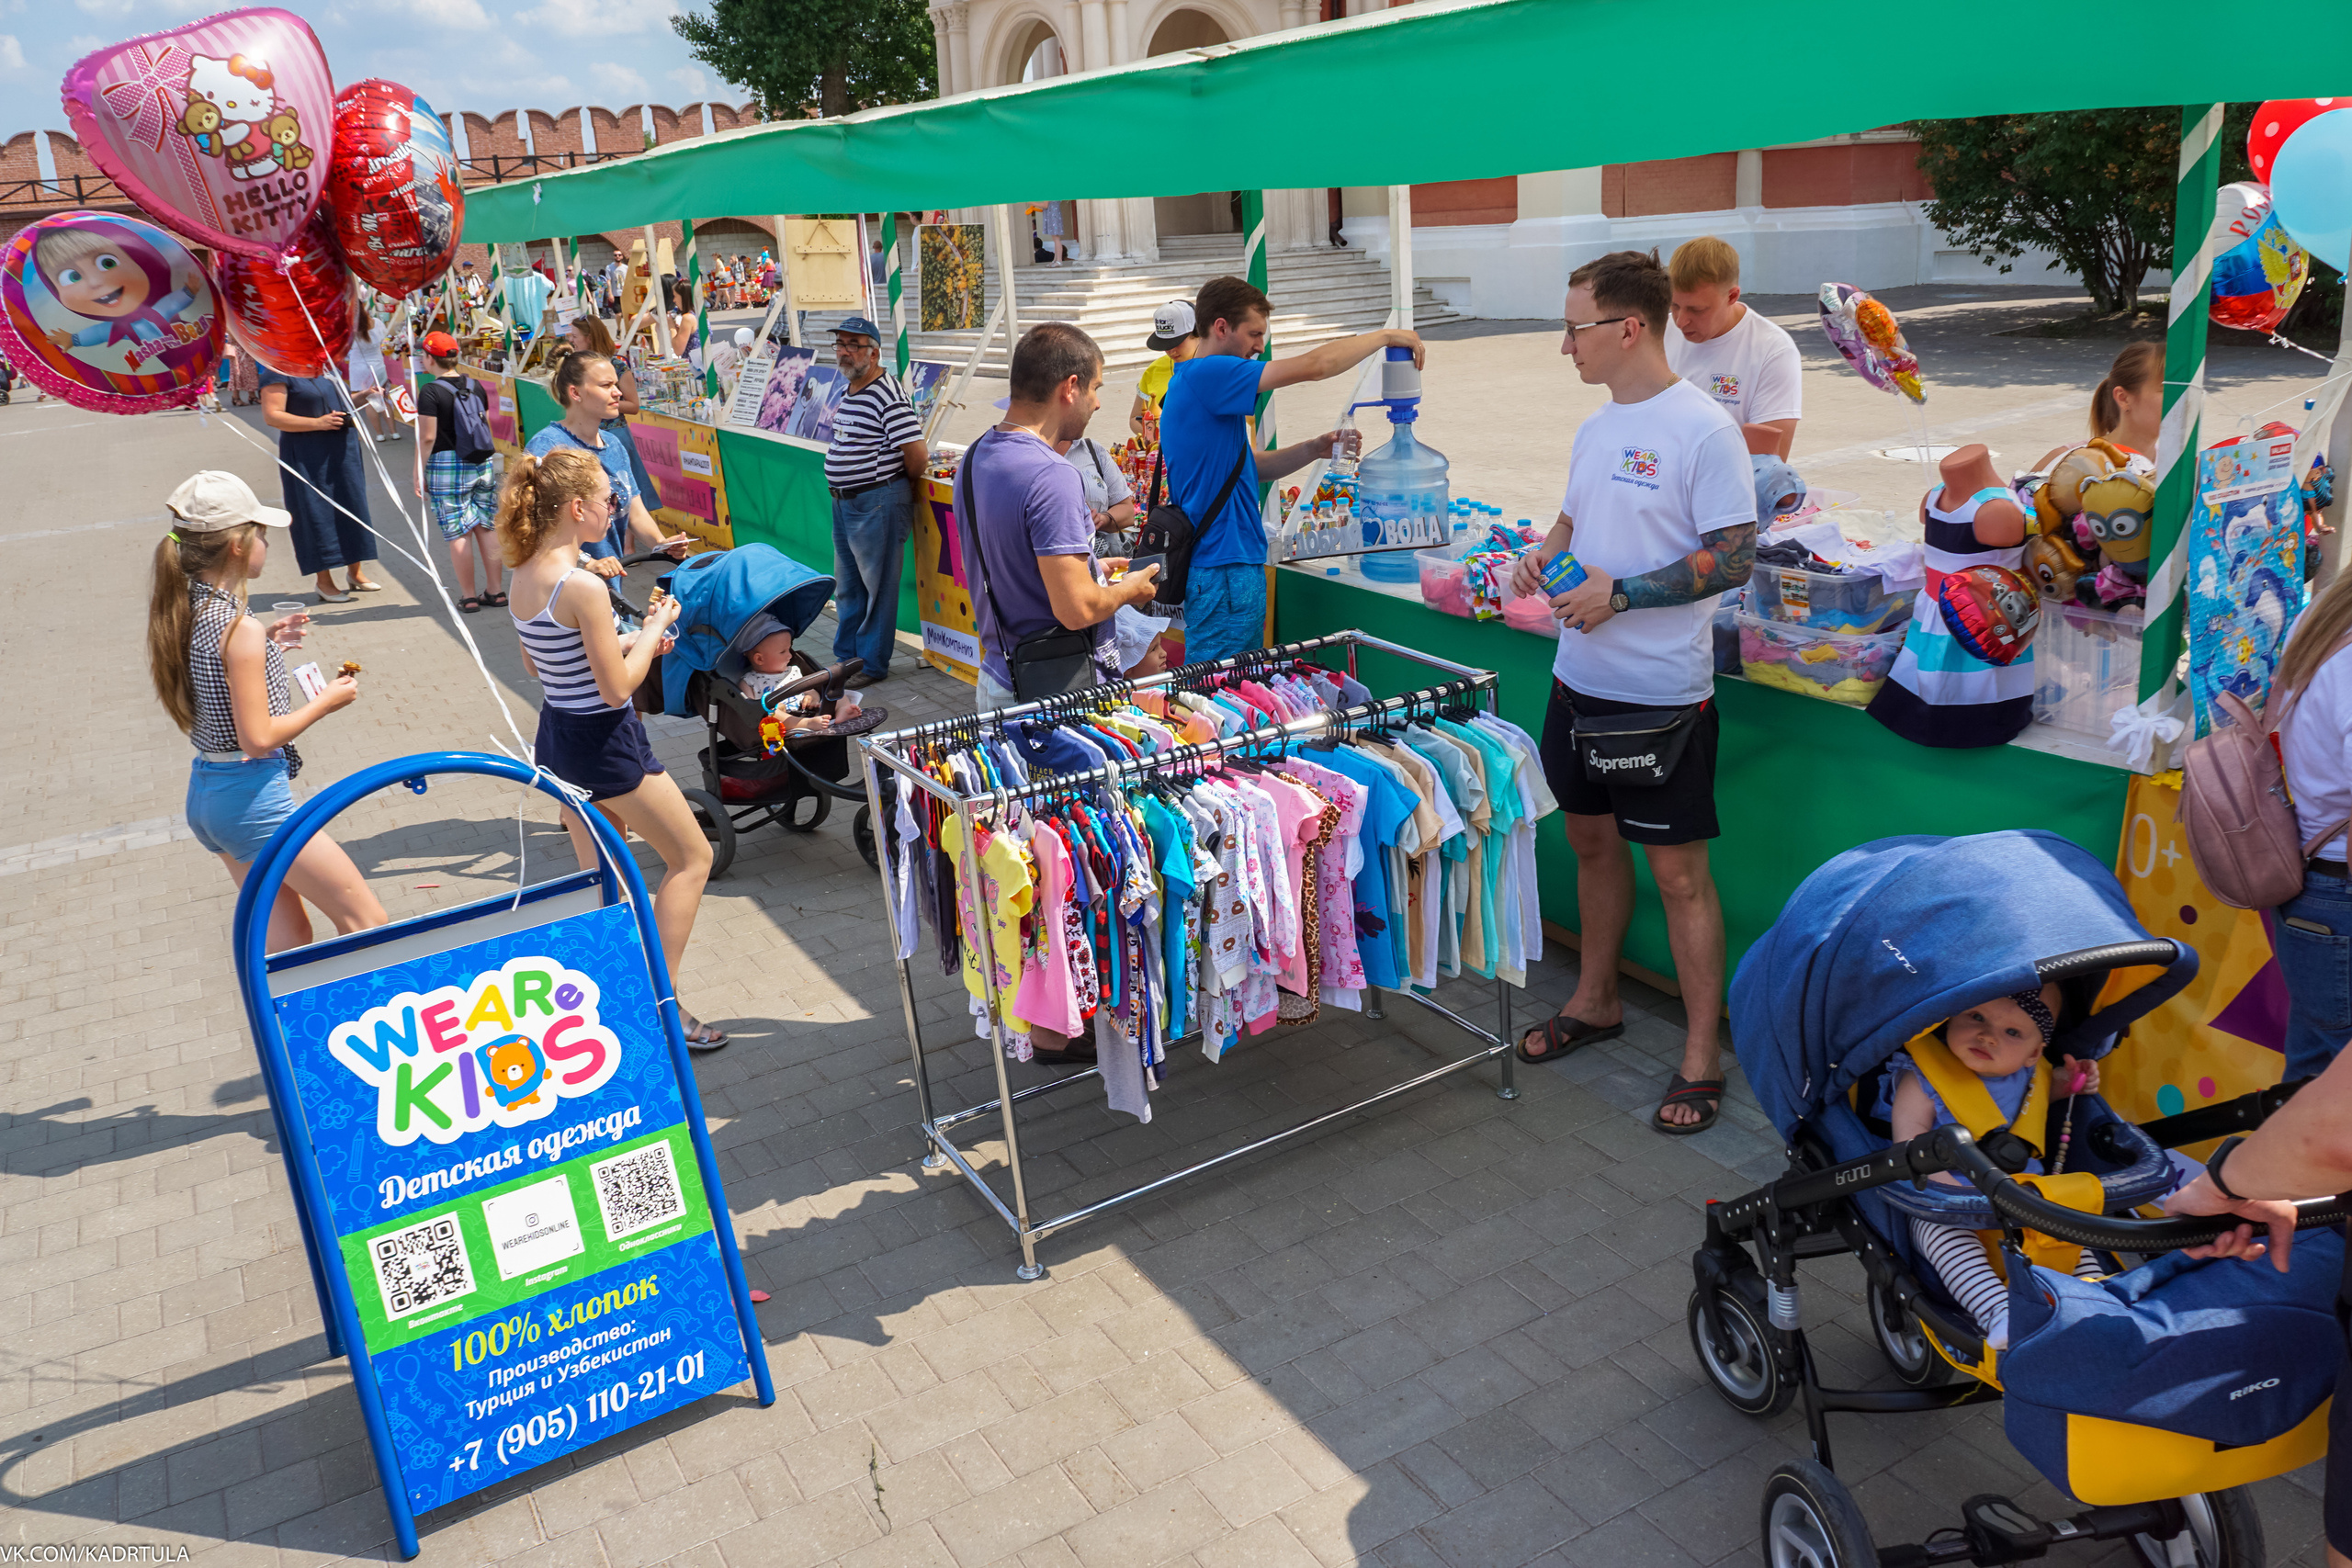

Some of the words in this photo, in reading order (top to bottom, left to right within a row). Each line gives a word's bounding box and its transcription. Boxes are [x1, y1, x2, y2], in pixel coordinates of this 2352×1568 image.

[394, 162, 407, 175] UP
[222, 171, 308, 214] HELLO
[231, 192, 311, 234] KITTY
[124, 337, 167, 373] Masha
[170, 315, 211, 345] Bear
[1611, 473, 1634, 484] Детская
[1634, 479, 1660, 491] одежда
[1384, 515, 1443, 547] ВОДА
[1029, 762, 1054, 776] BEACH
[1589, 749, 1657, 773] Supreme
[2126, 813, 2183, 879] 0+
[394, 1015, 606, 1132] KIDS
[378, 1145, 523, 1209] Детская
[527, 1105, 642, 1162] одежда
[1835, 1164, 1871, 1185] bruno
[501, 1219, 571, 1251] WEAREKIDSONLINE
[618, 1224, 683, 1252] Одноклассники
[525, 1266, 569, 1287] Instagram
[408, 1303, 464, 1330] Вконтакте
[449, 1311, 541, 1372] 100%
[548, 1274, 660, 1337] хлопок
[488, 1319, 637, 1388] Производство:
[465, 1379, 536, 1420] Турция
[540, 1372, 553, 1390] и
[558, 1326, 672, 1383] Узбекистан
[2229, 1378, 2280, 1401] RIKO
[449, 1438, 483, 1473] +7
[496, 1403, 579, 1465] (905)
[586, 1349, 706, 1423] 110-21-01
